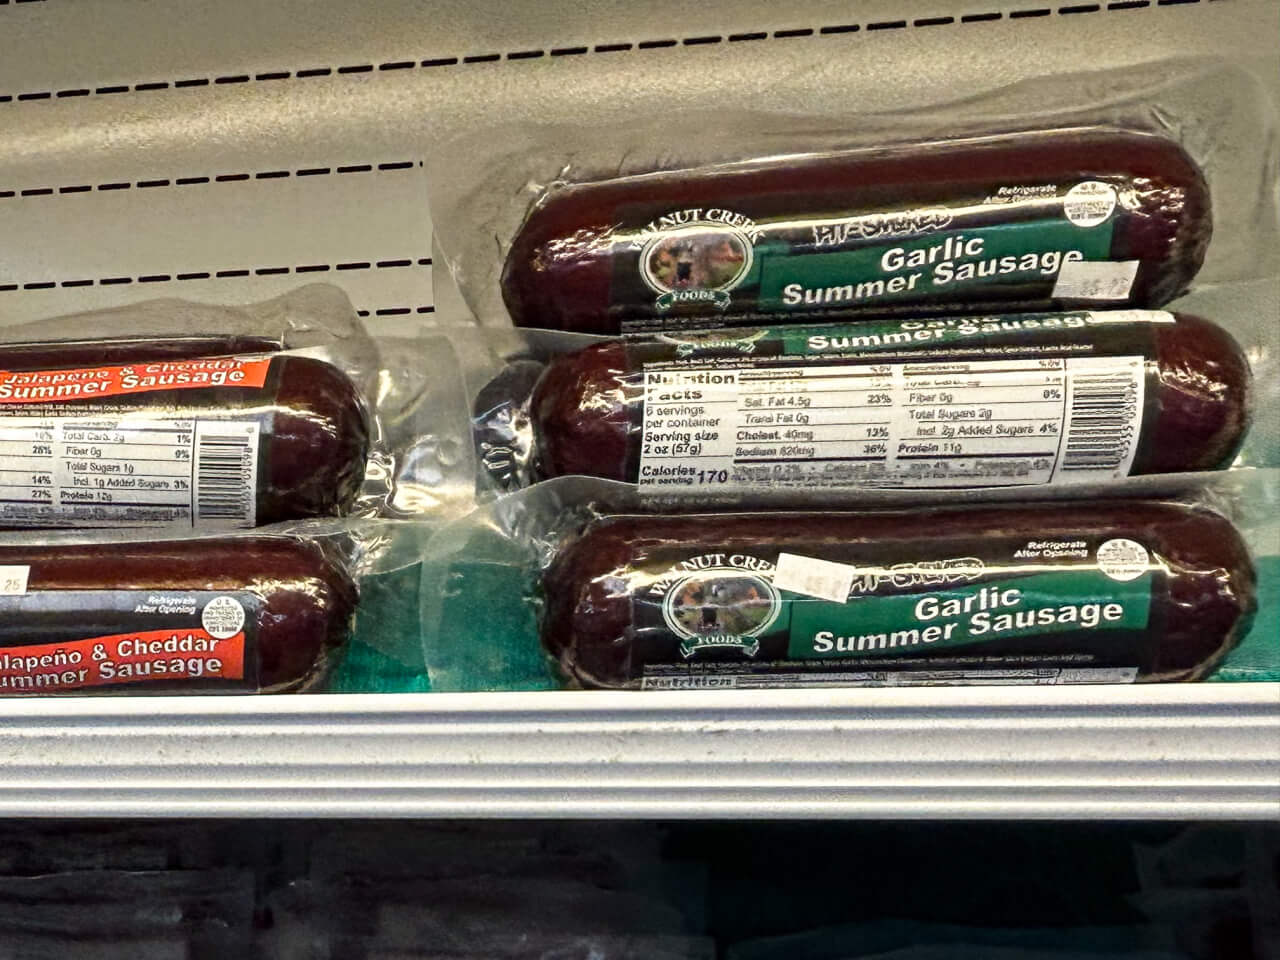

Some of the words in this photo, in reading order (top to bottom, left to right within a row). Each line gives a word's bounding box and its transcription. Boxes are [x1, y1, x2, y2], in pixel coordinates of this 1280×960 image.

[881, 235, 985, 272] Garlic
[783, 272, 923, 305] Summer
[932, 249, 1084, 287] Sausage
[807, 329, 944, 351] Summer
[122, 368, 246, 390] Sausage
[667, 416, 721, 428] container
[645, 431, 691, 445] Serving
[694, 430, 719, 442] size
[644, 445, 652, 455] 2
[641, 465, 697, 477] Calories
[696, 470, 729, 485] 170
[914, 586, 1021, 621] Garlic
[813, 621, 959, 653] Summer
[969, 602, 1124, 636] Sausage
[91, 644, 108, 661] &
[117, 633, 219, 657] Cheddar
[99, 656, 222, 678] Sausage
